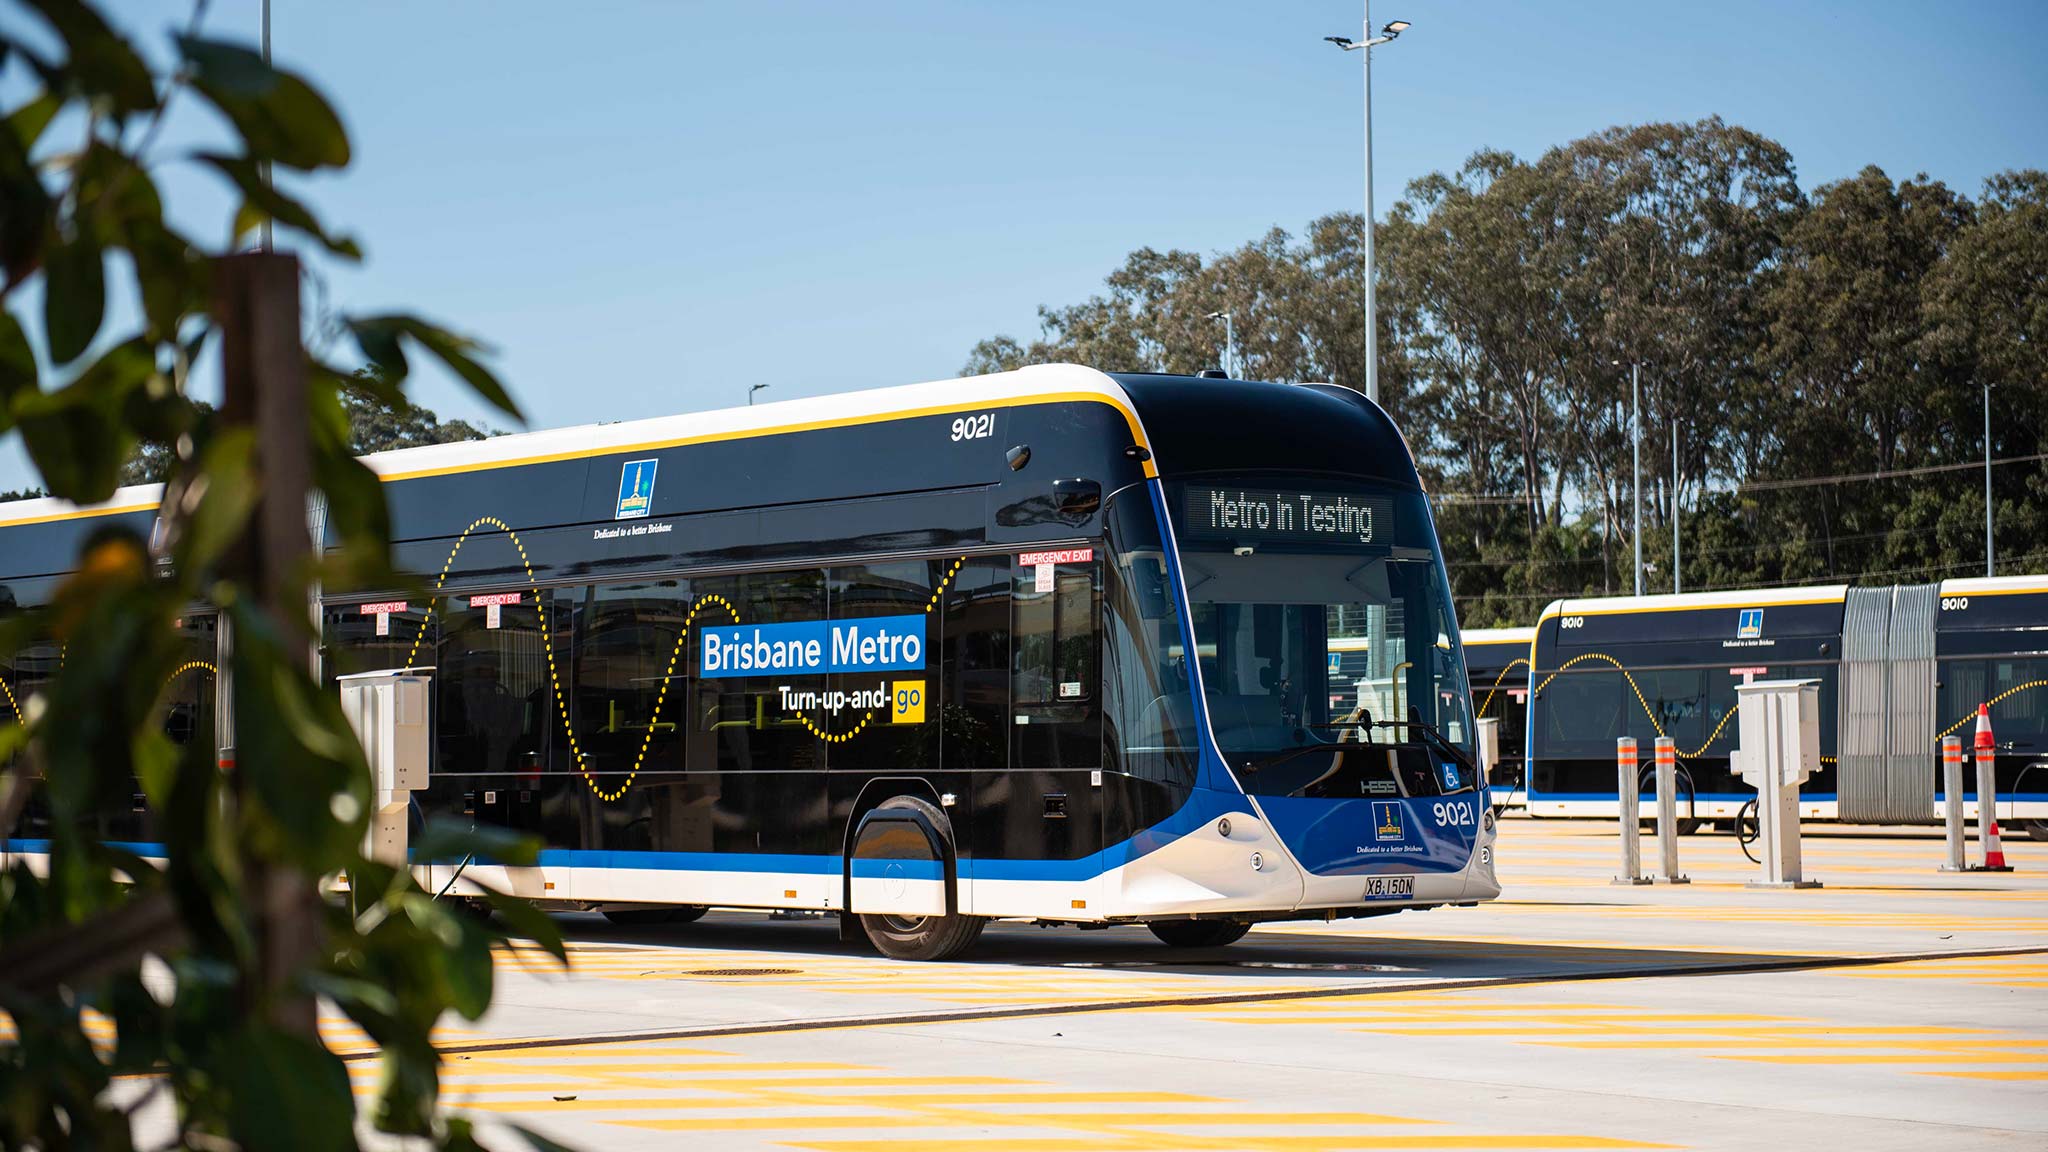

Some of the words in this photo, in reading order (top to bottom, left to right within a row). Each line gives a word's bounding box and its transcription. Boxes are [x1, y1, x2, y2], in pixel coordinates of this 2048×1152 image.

[951, 413, 995, 441] 9021
[1211, 490, 1270, 529] Metro
[1277, 493, 1293, 530] in
[1300, 495, 1372, 543] Testing
[593, 527, 620, 539] Dedicated
[620, 529, 626, 537] to
[632, 525, 647, 536] better
[648, 523, 672, 534] Brisbane
[1020, 551, 1071, 565] EMERGENCY
[1073, 549, 1091, 561] EXIT
[471, 595, 507, 606] EMERGENCY
[507, 593, 521, 604] EXIT
[1942, 597, 1968, 611] 9010
[361, 603, 394, 614] EMERGENCY
[395, 602, 407, 612] EXIT
[1561, 616, 1584, 629] 9010
[704, 629, 821, 671] Brisbane
[832, 626, 920, 666] Metro
[1361, 780, 1397, 795] HESS
[1433, 801, 1475, 827] 9021
